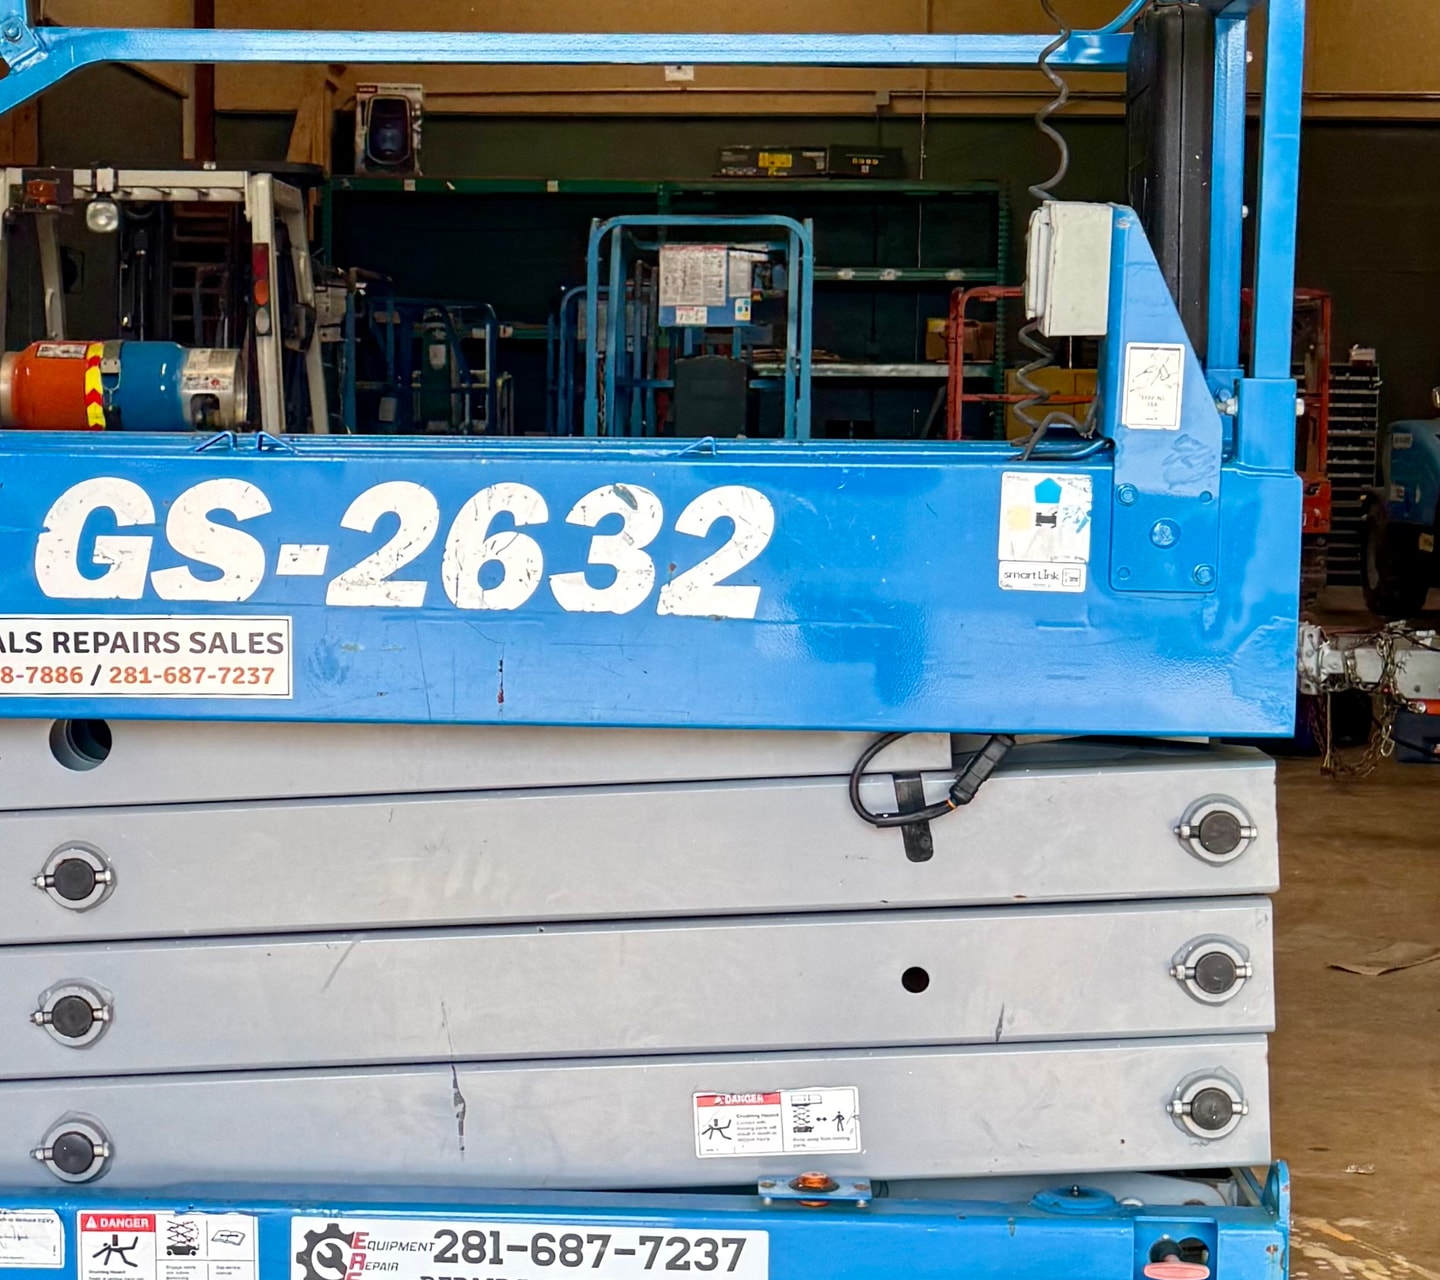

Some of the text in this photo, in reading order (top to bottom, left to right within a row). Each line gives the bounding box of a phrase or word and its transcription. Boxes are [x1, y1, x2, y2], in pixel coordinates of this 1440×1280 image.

[34, 476, 775, 620] GS-2632
[53, 631, 180, 655] REPAIRS
[189, 632, 285, 655] SALES
[90, 664, 102, 686] /
[109, 666, 275, 685] 281-687-7237
[725, 1094, 764, 1104] DANGER
[100, 1218, 149, 1228] DANGER
[353, 1232, 436, 1251] EQUIPMENT
[433, 1229, 747, 1272] 281-687-7237
[349, 1253, 399, 1271] REPAIR
